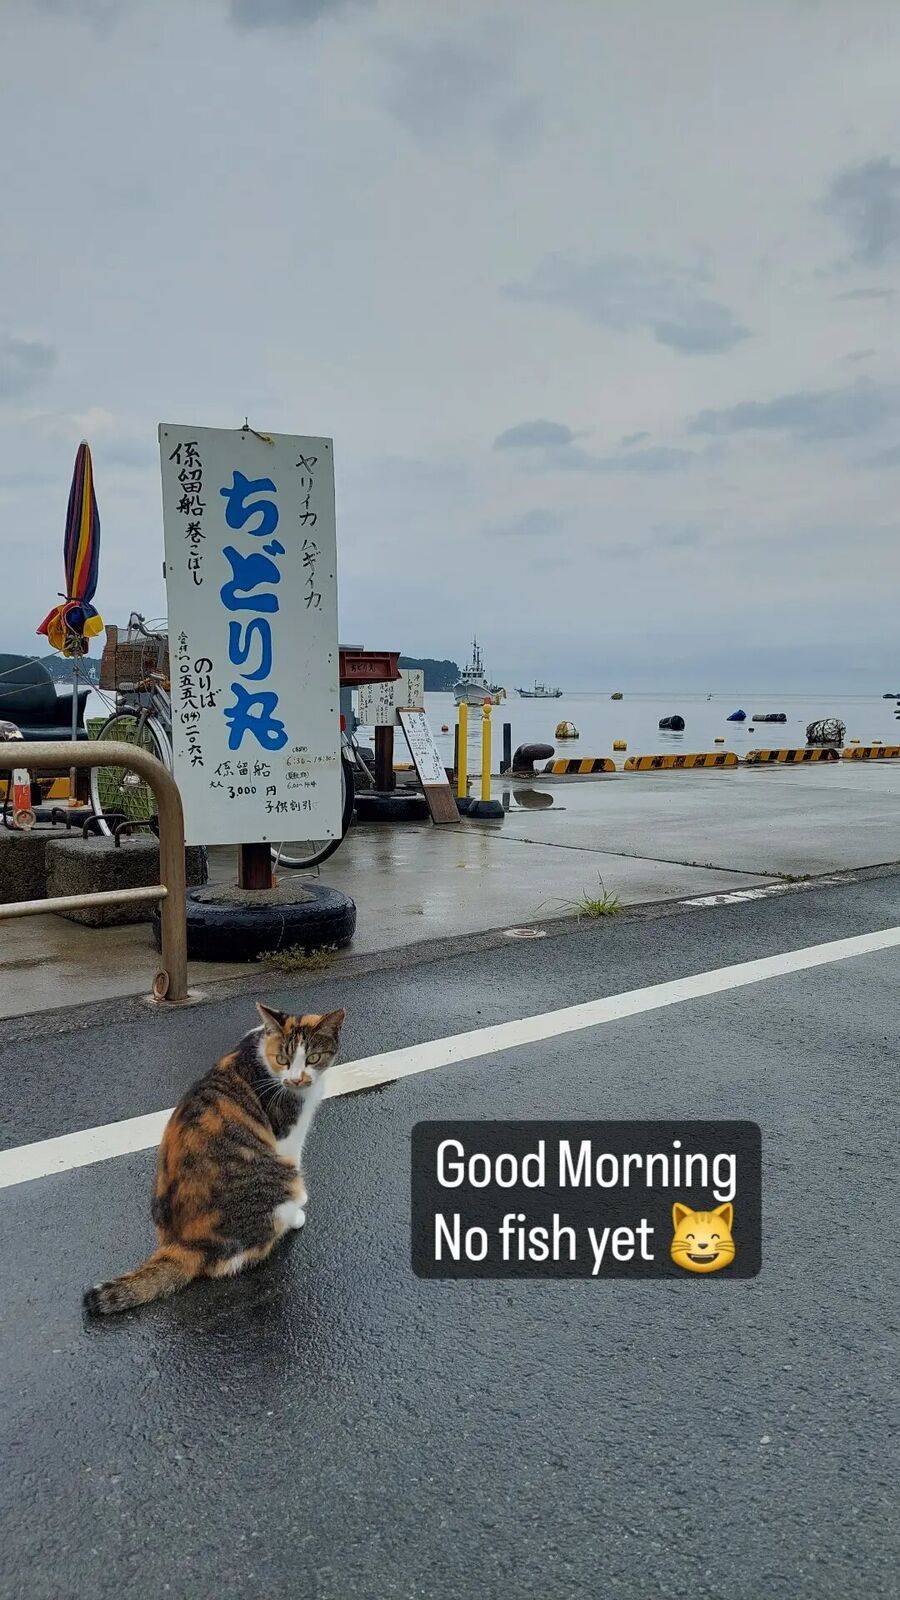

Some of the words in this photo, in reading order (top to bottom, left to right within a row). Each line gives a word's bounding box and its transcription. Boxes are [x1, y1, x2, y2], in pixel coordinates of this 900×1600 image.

[169, 441, 206, 516] 係留船
[296, 454, 318, 527] ヤリイカ
[219, 470, 289, 751] ちどり丸
[194, 657, 221, 708] のりば
[214, 760, 271, 778] 係留船
[265, 784, 277, 797] 円
[265, 799, 312, 814] 子供割引
